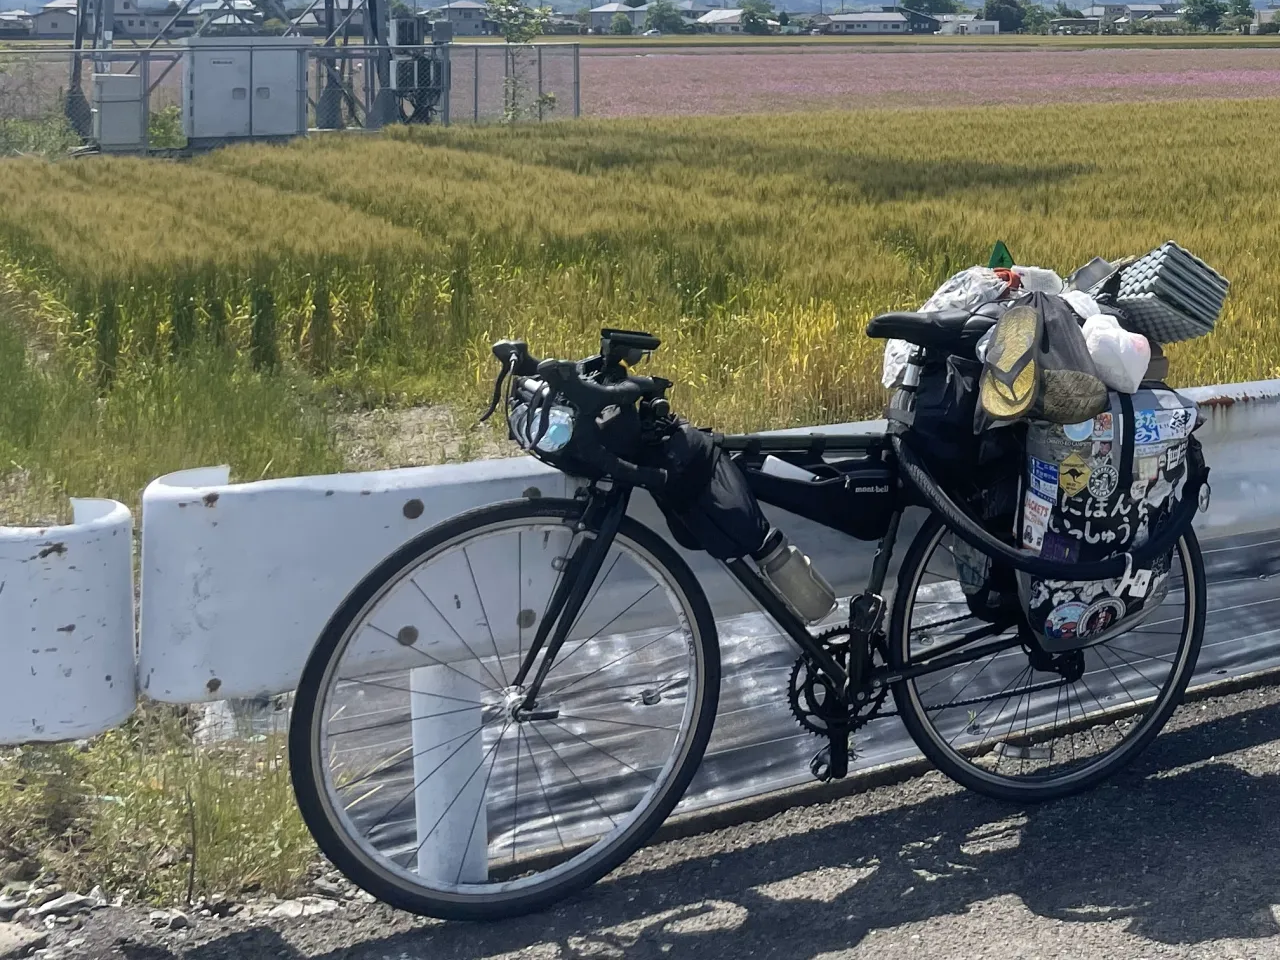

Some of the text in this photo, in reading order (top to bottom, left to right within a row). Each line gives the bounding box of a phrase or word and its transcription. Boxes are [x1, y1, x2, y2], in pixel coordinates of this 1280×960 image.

[1061, 493, 1132, 518] にほん
[1048, 515, 1132, 544] いっしゅう
